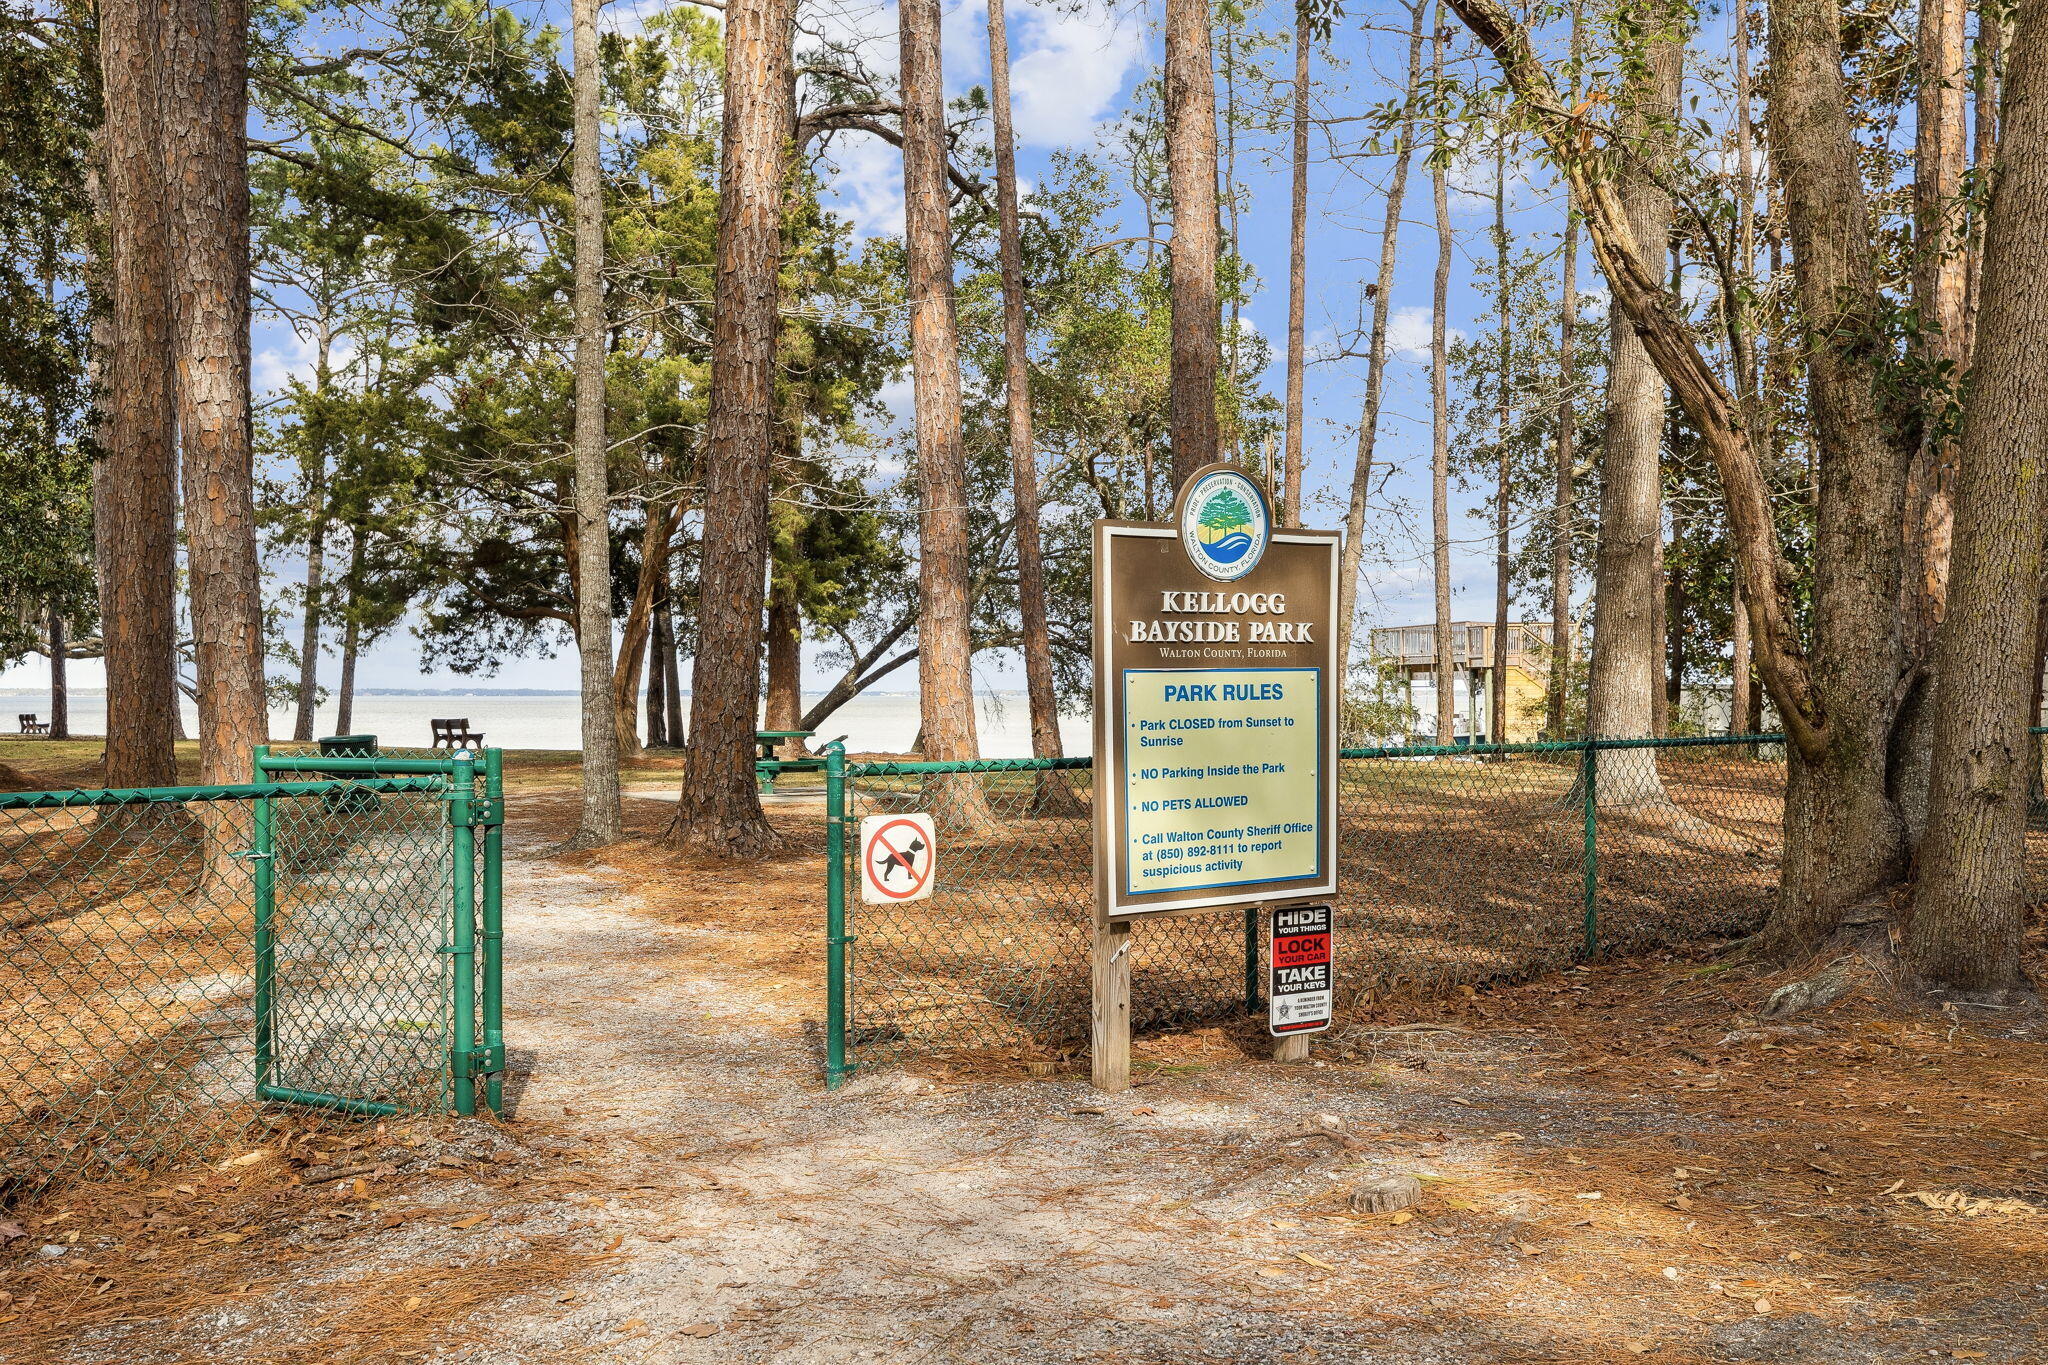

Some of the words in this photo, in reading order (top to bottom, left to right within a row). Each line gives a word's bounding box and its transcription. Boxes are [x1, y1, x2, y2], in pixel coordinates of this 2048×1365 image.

[1200, 478, 1232, 495] PRESERVATION
[1237, 483, 1260, 518] CONSERVATION
[1190, 531, 1207, 565] WALTON
[1208, 562, 1240, 573] COUNTY,
[1242, 533, 1261, 567] FLORIDA
[1161, 591, 1286, 614] KELLOGG
[1130, 621, 1240, 643] BAYSIDE
[1248, 622, 1314, 643] PARK
[1160, 648, 1200, 658] WALTON
[1204, 648, 1244, 659] COUNTY,
[1248, 648, 1287, 658] FLORIDA
[1164, 684, 1217, 702] PARK
[1223, 683, 1283, 701] RULES
[1140, 720, 1165, 730] Park
[1169, 718, 1215, 730] CLOSED
[1218, 718, 1243, 728] from
[1246, 717, 1281, 728] Sunset
[1284, 717, 1294, 726] to
[1140, 735, 1183, 747] Sunrise
[1141, 769, 1158, 779] NO
[1162, 766, 1204, 779] Parking
[1207, 765, 1239, 776] Inside
[1243, 764, 1259, 774] the
[1262, 763, 1285, 773] Park
[1142, 801, 1159, 812] NO
[1162, 799, 1191, 811] PETS
[1194, 795, 1248, 809] ALLOWED
[1142, 833, 1163, 845] Call
[1166, 831, 1203, 843] Walton
[1207, 828, 1244, 841] County
[1247, 824, 1280, 836] Sheriff
[1283, 822, 1313, 833] Office
[1142, 851, 1153, 861] at
[1156, 848, 1184, 862] (850)
[1188, 845, 1234, 857] 892-8111
[1238, 843, 1248, 853] to
[1251, 840, 1282, 853] report
[1142, 864, 1202, 878] suspicious
[1205, 860, 1243, 872] activity
[1278, 909, 1326, 926] HIDE
[1278, 938, 1325, 954] LOCK
[1279, 955, 1304, 964] YOUR
[1307, 953, 1325, 961] CAR
[1278, 966, 1326, 983] TAKE
[1278, 983, 1302, 993] YOUR
[1304, 981, 1325, 989] KEYS
